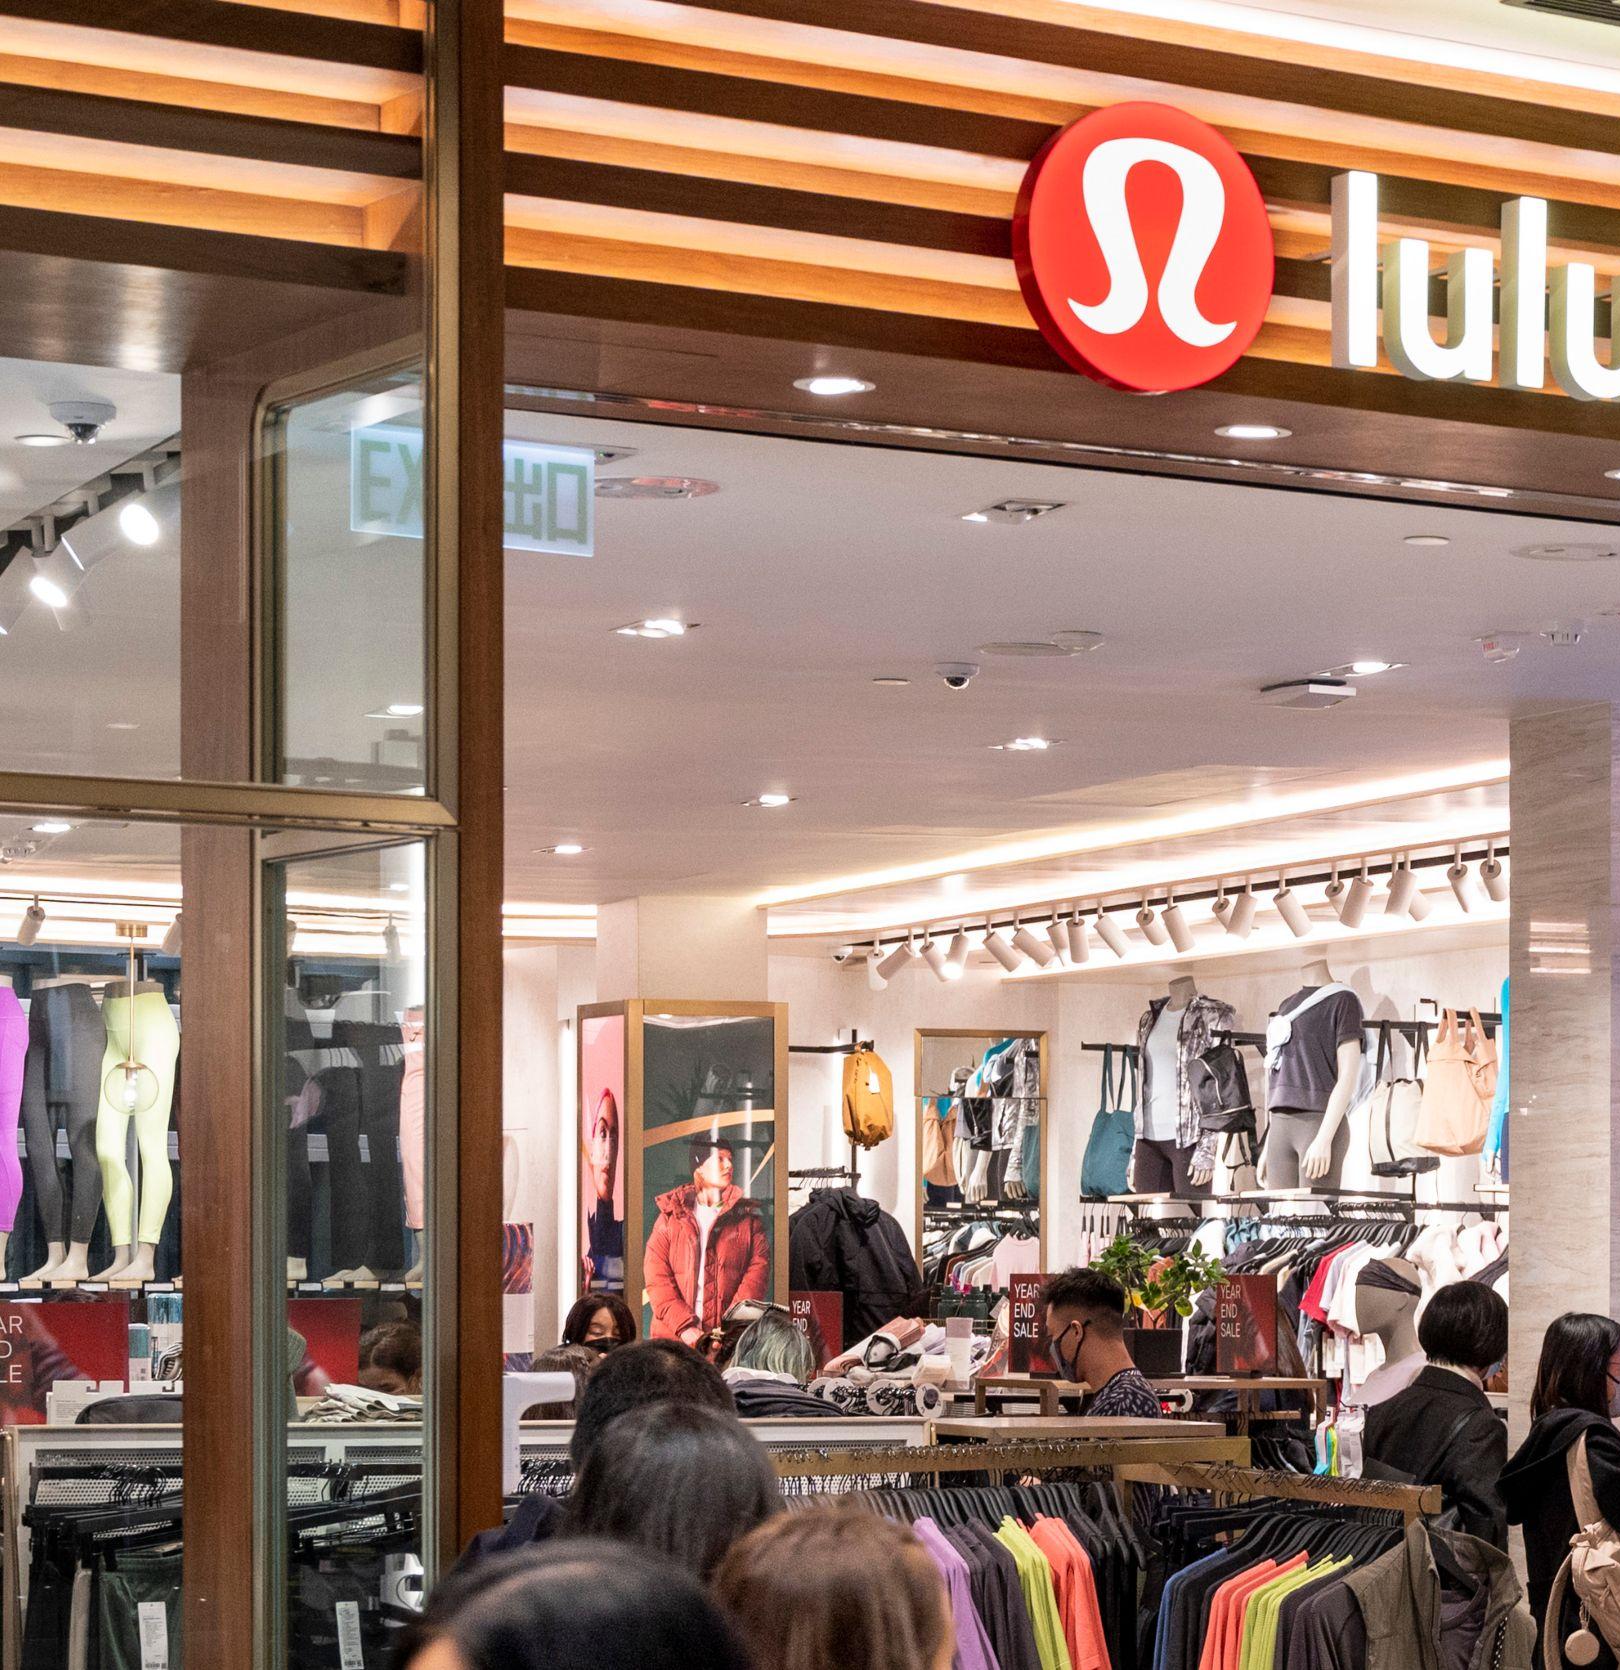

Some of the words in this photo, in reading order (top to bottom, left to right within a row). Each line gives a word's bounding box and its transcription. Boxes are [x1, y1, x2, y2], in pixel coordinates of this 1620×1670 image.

[503, 458, 587, 545] 出口
[1014, 1283, 1041, 1299] YEAR
[1220, 1284, 1241, 1299] YEAR
[792, 1300, 811, 1315] YEAR
[1014, 1302, 1036, 1318] END
[1220, 1303, 1238, 1319] END
[1013, 1321, 1039, 1338] SALE
[1220, 1322, 1241, 1338] SALE
